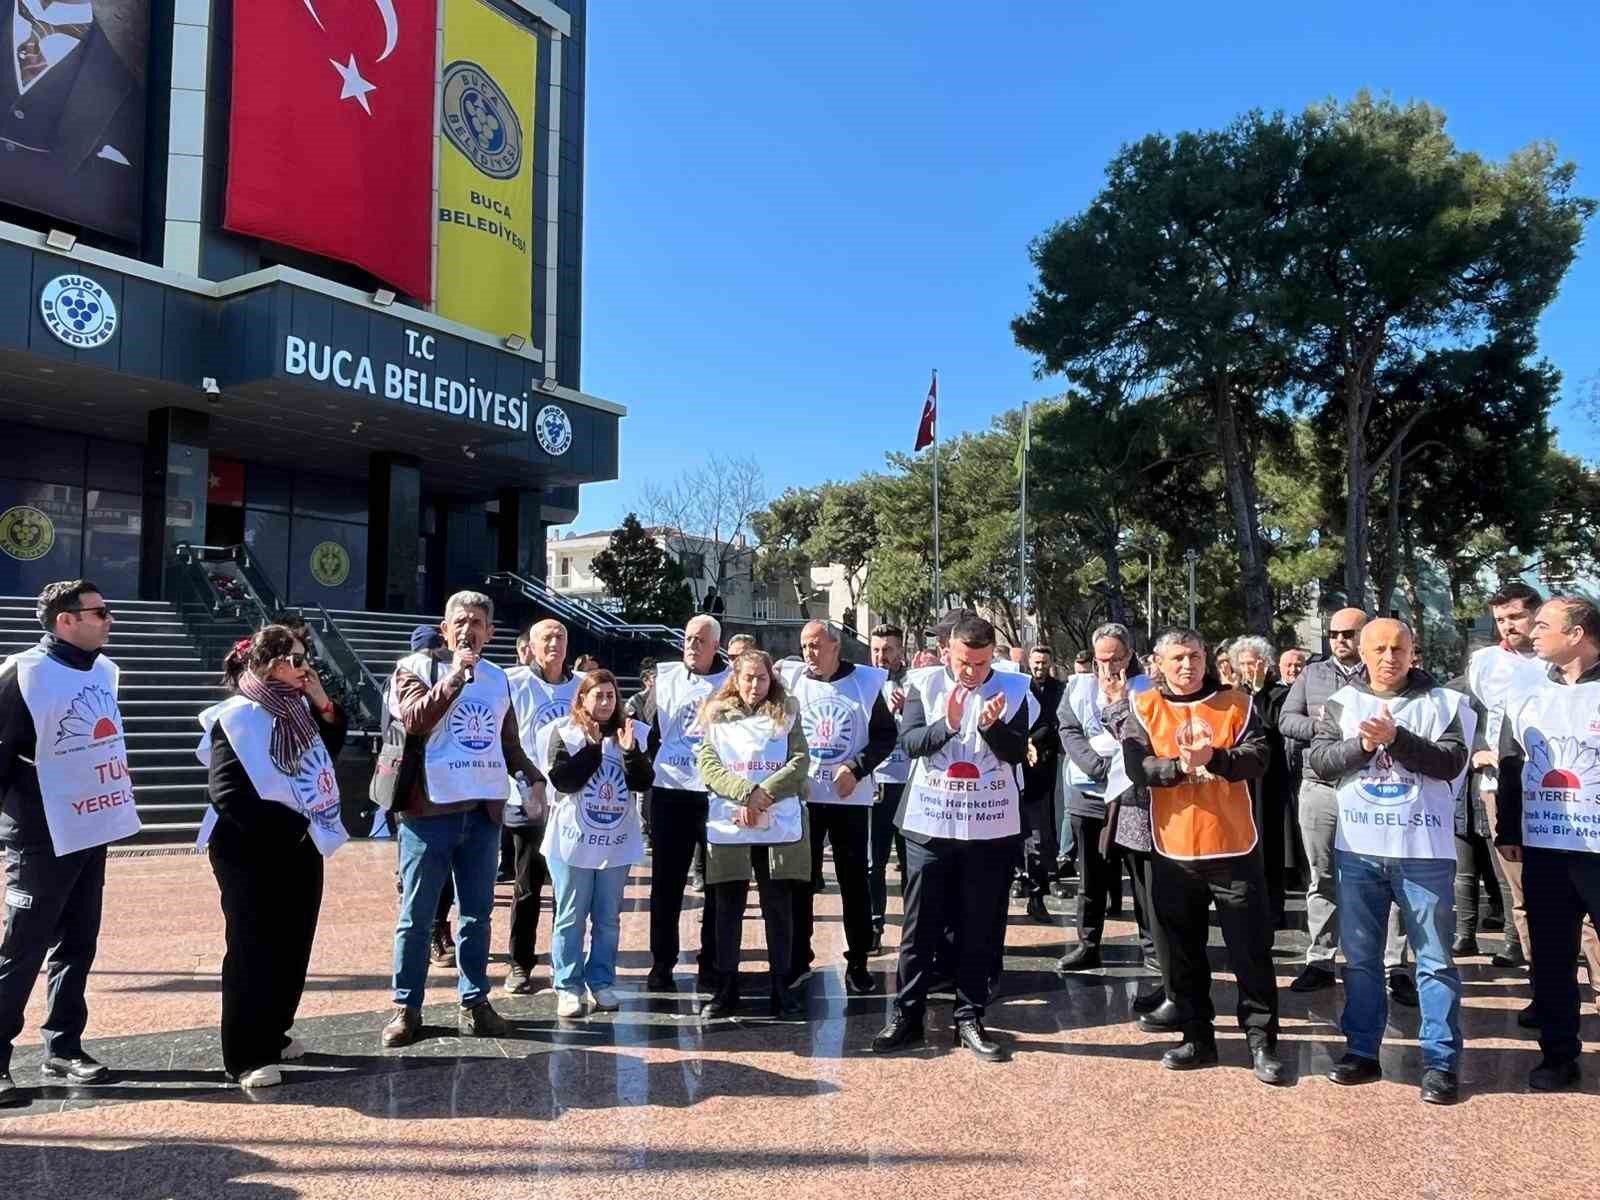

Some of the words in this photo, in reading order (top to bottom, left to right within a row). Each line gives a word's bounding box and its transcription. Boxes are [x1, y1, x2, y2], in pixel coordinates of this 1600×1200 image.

[460, 74, 499, 106] BUCA
[470, 190, 512, 220] BUCA
[58, 277, 102, 298] BUCA
[405, 329, 435, 361] T.C
[285, 335, 376, 394] BUCA
[385, 363, 528, 432] BELEDİYESİ
[944, 780, 980, 791] YEREL
[1539, 791, 1579, 803] YEREL
[1344, 808, 1368, 825] TÜM
[1374, 812, 1441, 828] BEL-SEN
[1553, 824, 1571, 836] Bir
